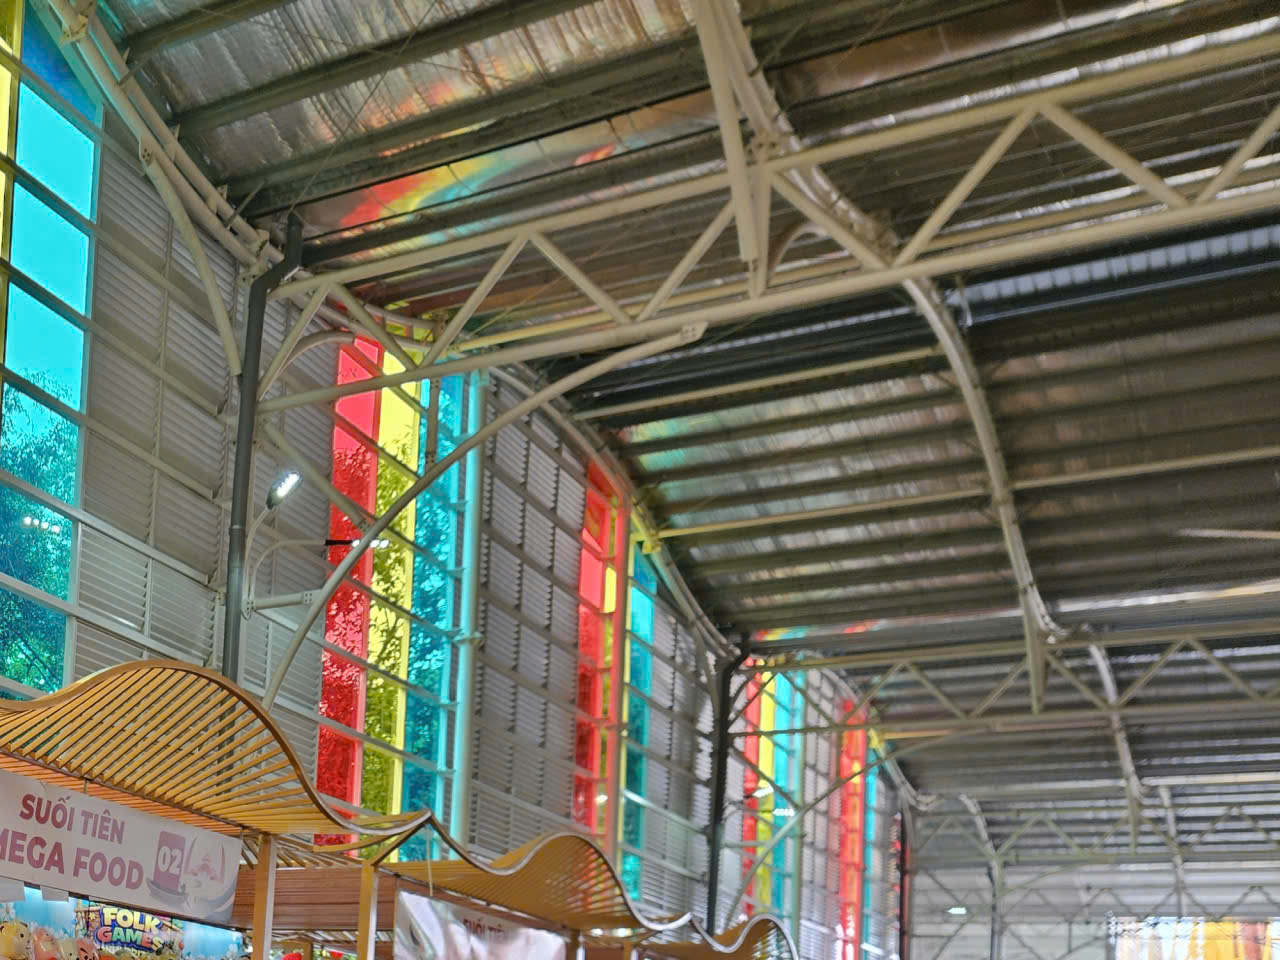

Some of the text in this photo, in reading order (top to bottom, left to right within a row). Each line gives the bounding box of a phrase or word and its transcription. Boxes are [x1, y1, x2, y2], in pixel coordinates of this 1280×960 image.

[19, 793, 76, 832] SUỐI
[80, 809, 125, 845] TIÊN
[73, 847, 144, 890] FOOD
[158, 846, 183, 875] 02
[102, 907, 162, 935] FOLK
[97, 926, 164, 952] GAMES
